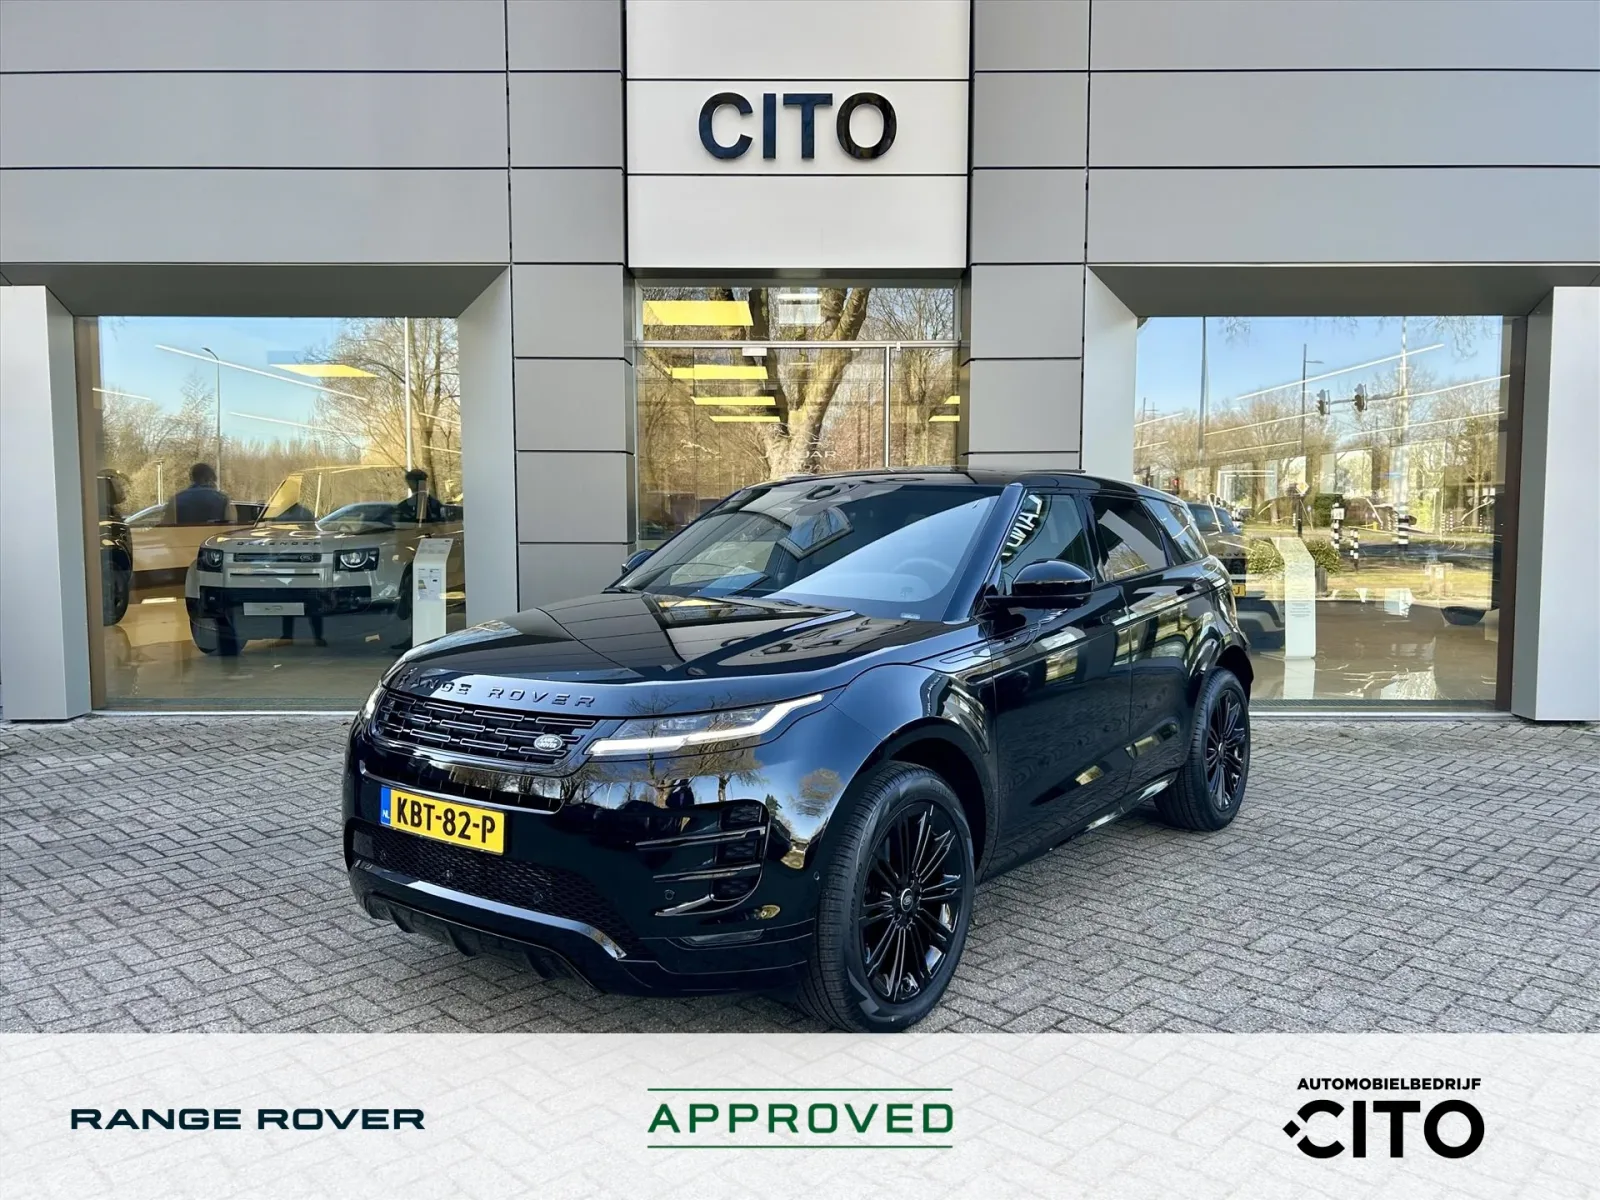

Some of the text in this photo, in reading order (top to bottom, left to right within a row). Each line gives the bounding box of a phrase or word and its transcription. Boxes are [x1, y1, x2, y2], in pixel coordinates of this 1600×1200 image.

[698, 92, 898, 160] CITO
[487, 686, 596, 708] ROVER
[396, 796, 496, 844] KBT-82-P
